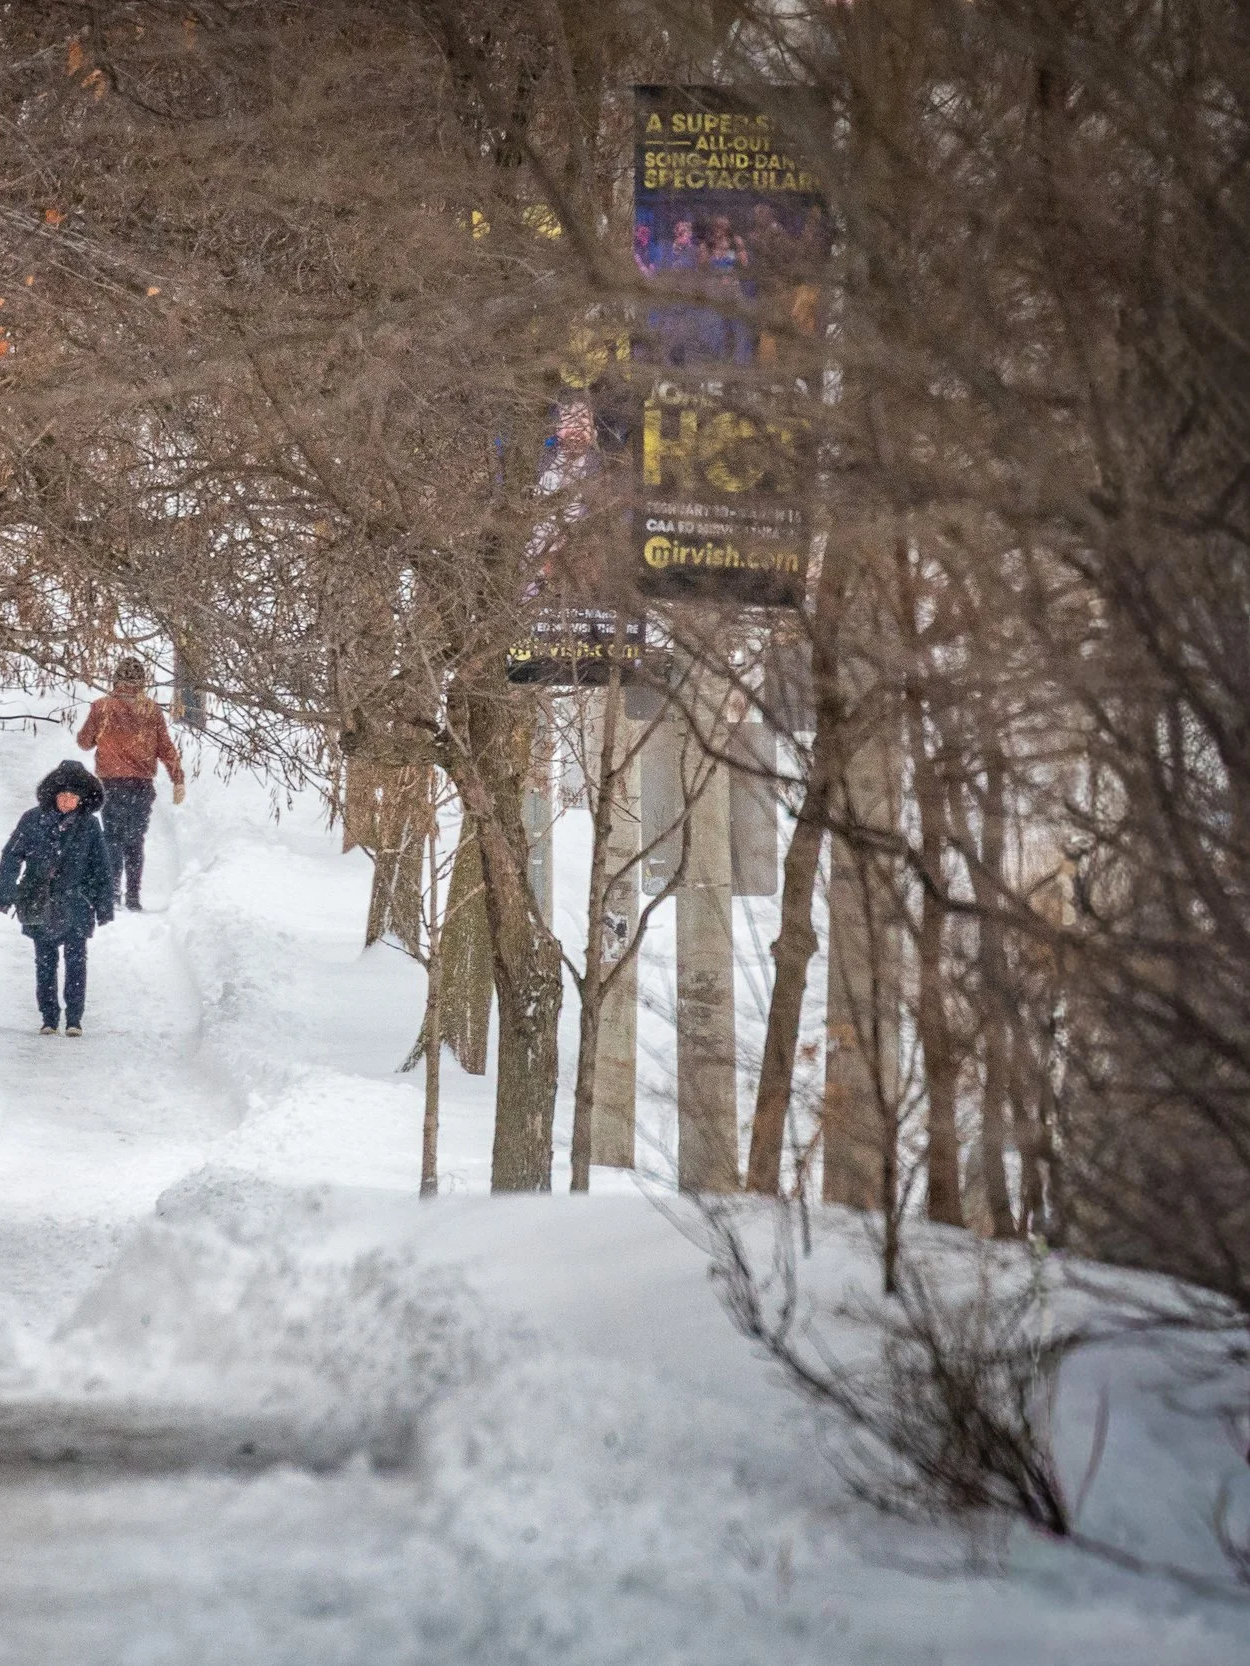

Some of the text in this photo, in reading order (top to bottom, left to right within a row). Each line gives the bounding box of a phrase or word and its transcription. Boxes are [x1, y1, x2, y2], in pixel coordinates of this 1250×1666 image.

[646, 113, 662, 133] A
[695, 136, 771, 151] ALL-OUT
[645, 152, 796, 171] SONG-AND-DAN
[645, 519, 676, 533] CAA
[644, 535, 799, 572] mirvish.com
[509, 639, 639, 661] mvish.com
